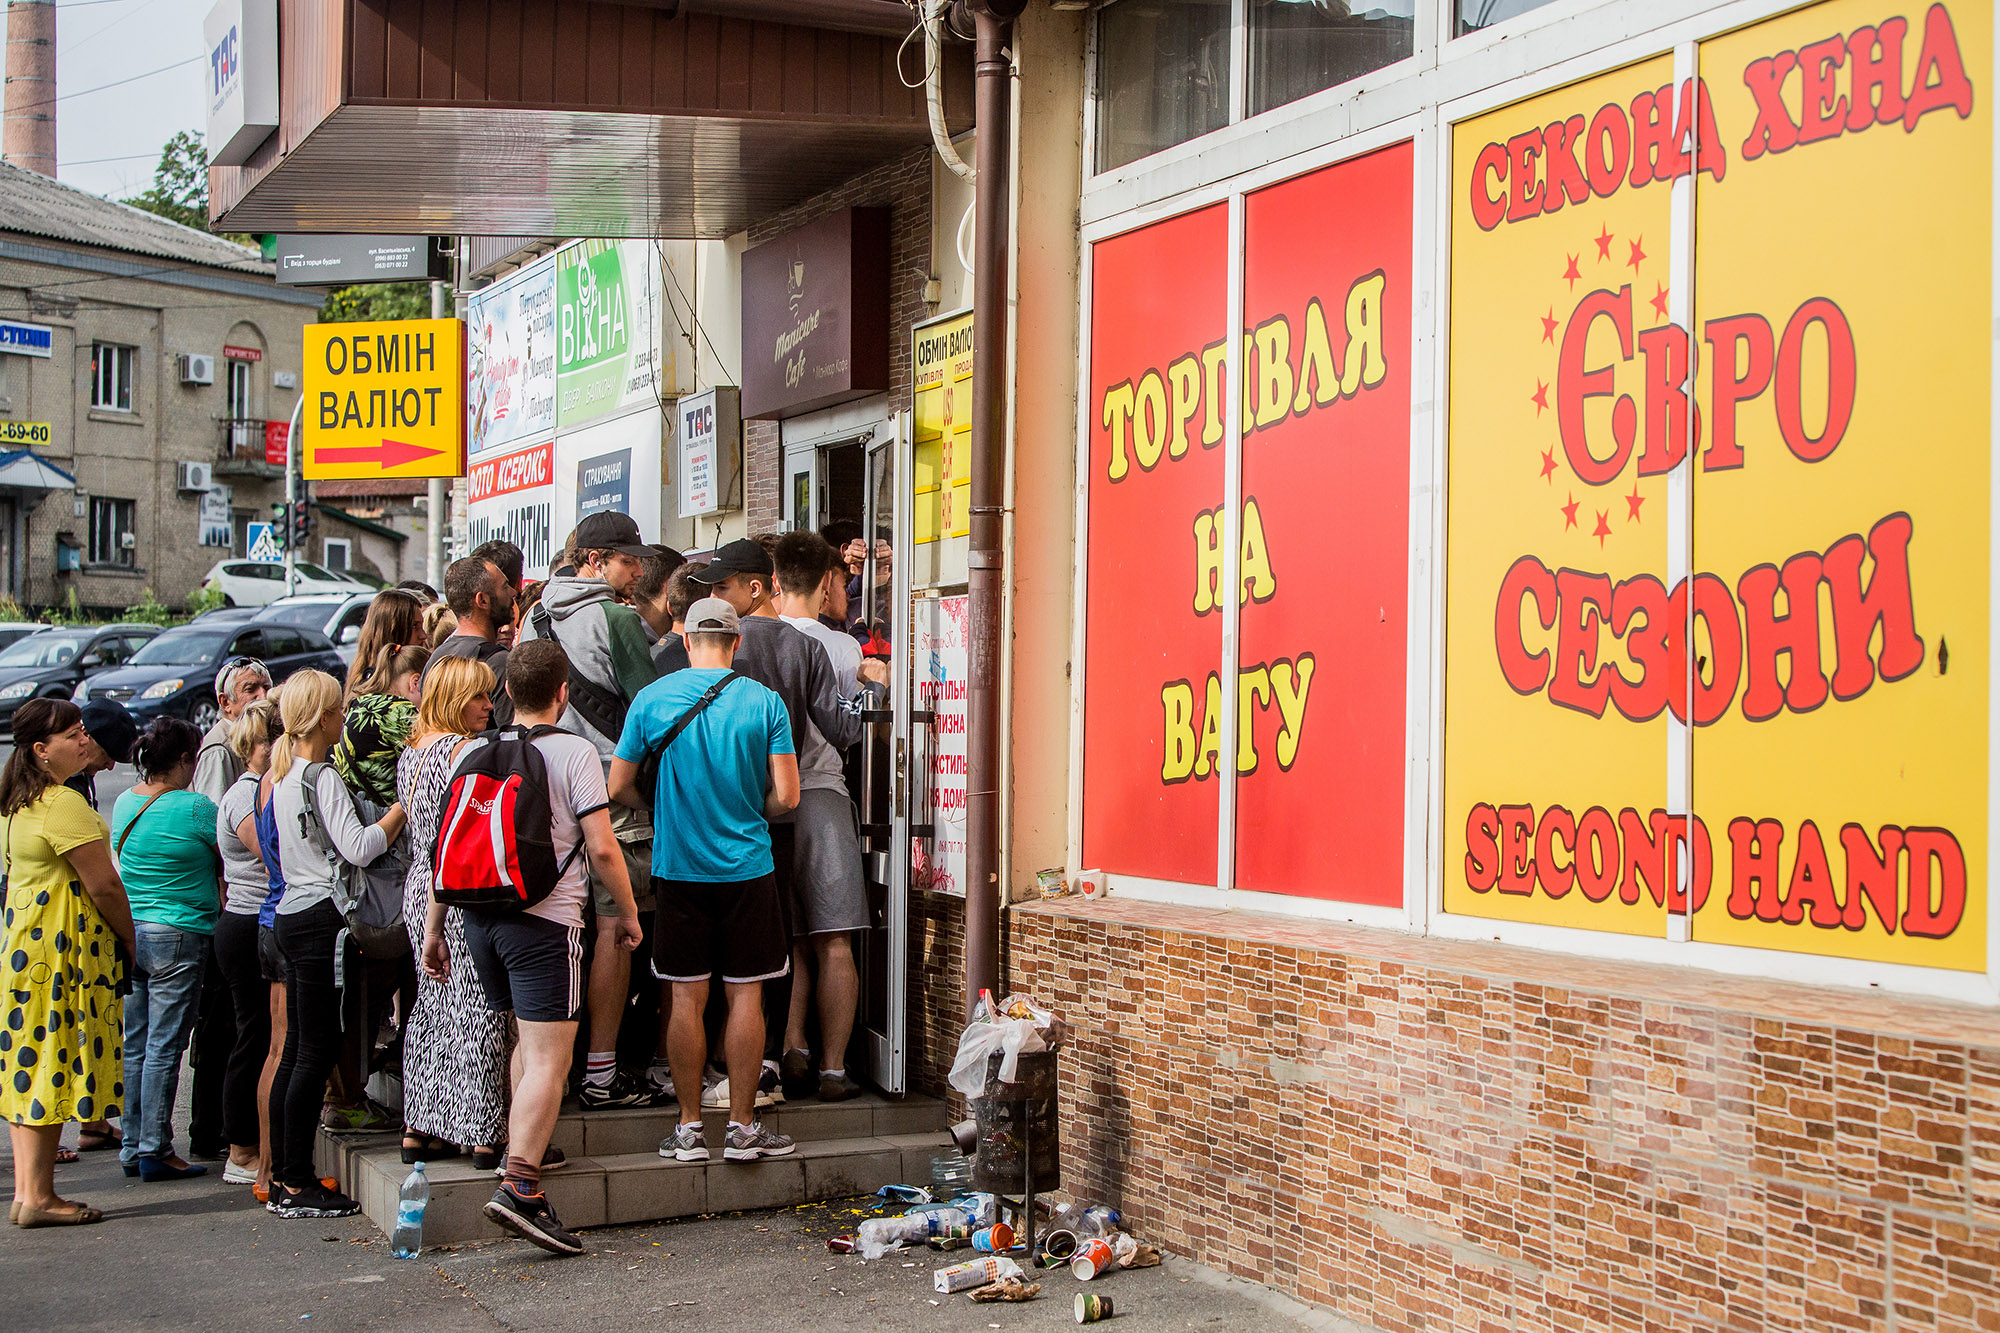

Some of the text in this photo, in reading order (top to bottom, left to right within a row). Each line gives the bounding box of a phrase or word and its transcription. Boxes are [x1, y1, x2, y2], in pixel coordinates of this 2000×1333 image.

[211, 25, 238, 96] ТАС
[1470, 2, 1973, 232] СЕКОНД ХЕНД
[326, 333, 435, 375] ОБМІН
[774, 309, 820, 364] Manicure
[918, 325, 974, 367] ОБМІН ВАЛЮ
[785, 348, 806, 388] Cafe
[915, 368, 944, 386] КУПІВЛЯ
[1557, 283, 1857, 487] ЄВРО
[319, 387, 442, 430] ВАЛЮТ
[685, 405, 713, 440] ТАС
[0, 423, 48, 442] -69-60
[497, 448, 547, 492] КСЕРОКС
[1193, 496, 1276, 617] НА
[1495, 511, 1925, 727] СЕЗОНИ
[930, 714, 965, 734] ЛИЗНА
[1161, 652, 1316, 786] ВАГУ
[922, 754, 968, 775] КСТИЛЬ
[1464, 802, 1968, 939] SECOND HAND
